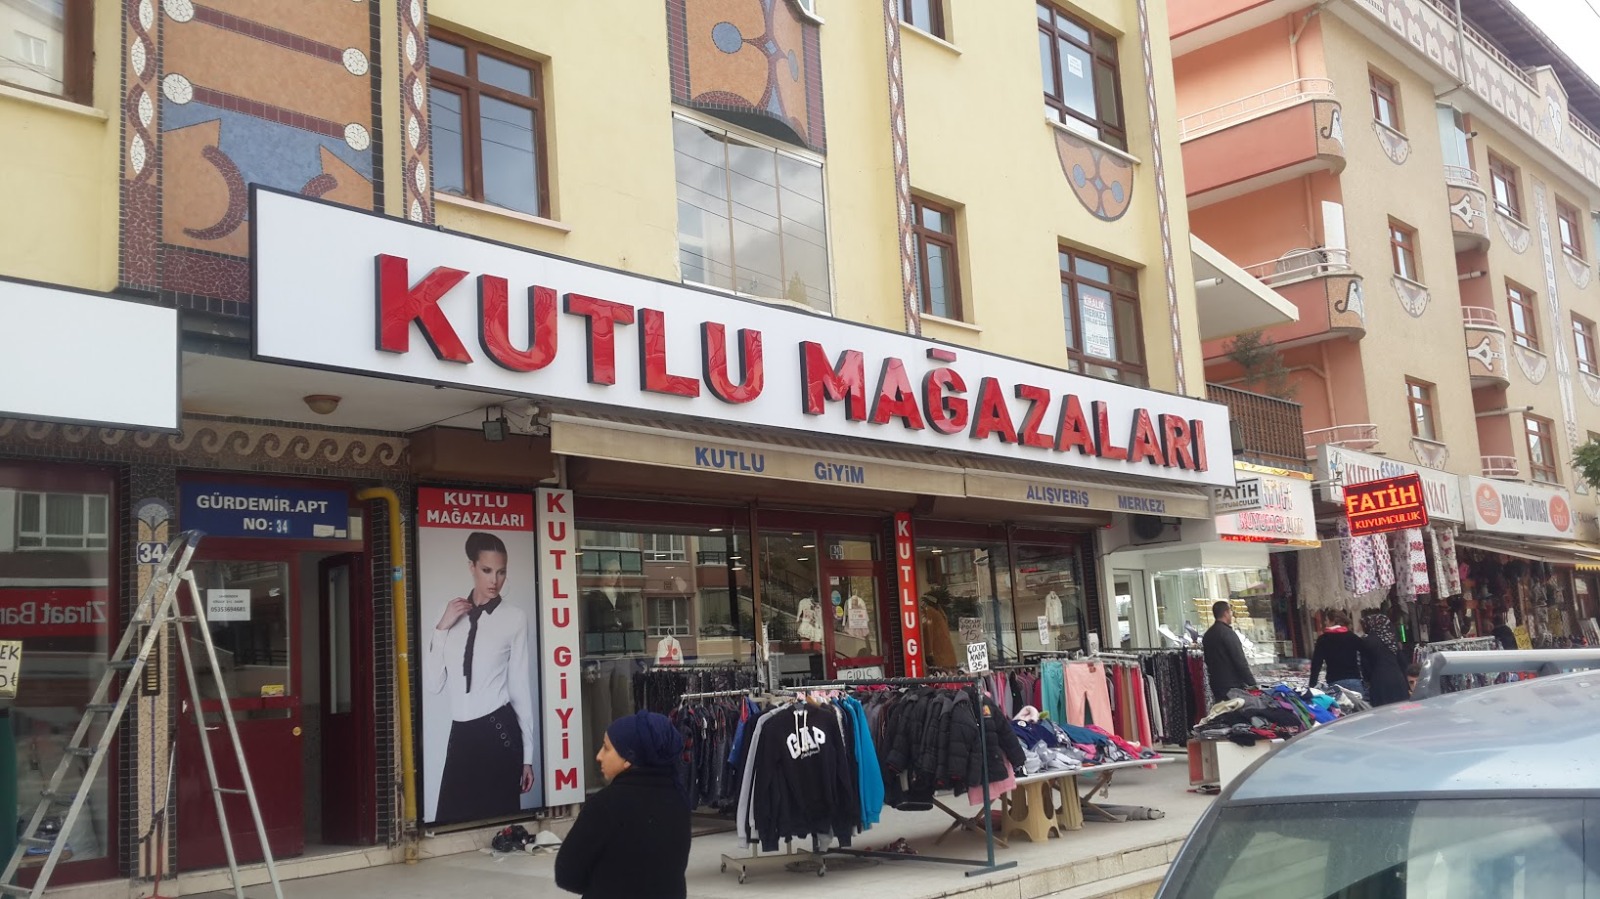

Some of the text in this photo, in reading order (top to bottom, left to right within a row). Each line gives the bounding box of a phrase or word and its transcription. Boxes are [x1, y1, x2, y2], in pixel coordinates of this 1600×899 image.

[374, 253, 1208, 472] KUTLU MAĞAZALARI
[694, 447, 765, 473] KUTLU
[444, 492, 509, 508] KUTLU
[1345, 484, 1418, 513] FATİH
[426, 508, 525, 527] MAĞAZALARI
[1355, 511, 1421, 530] KUYUMCULUK
[140, 543, 163, 562] 34
[546, 492, 570, 628] KUTLU
[897, 520, 915, 629] KUTLU
